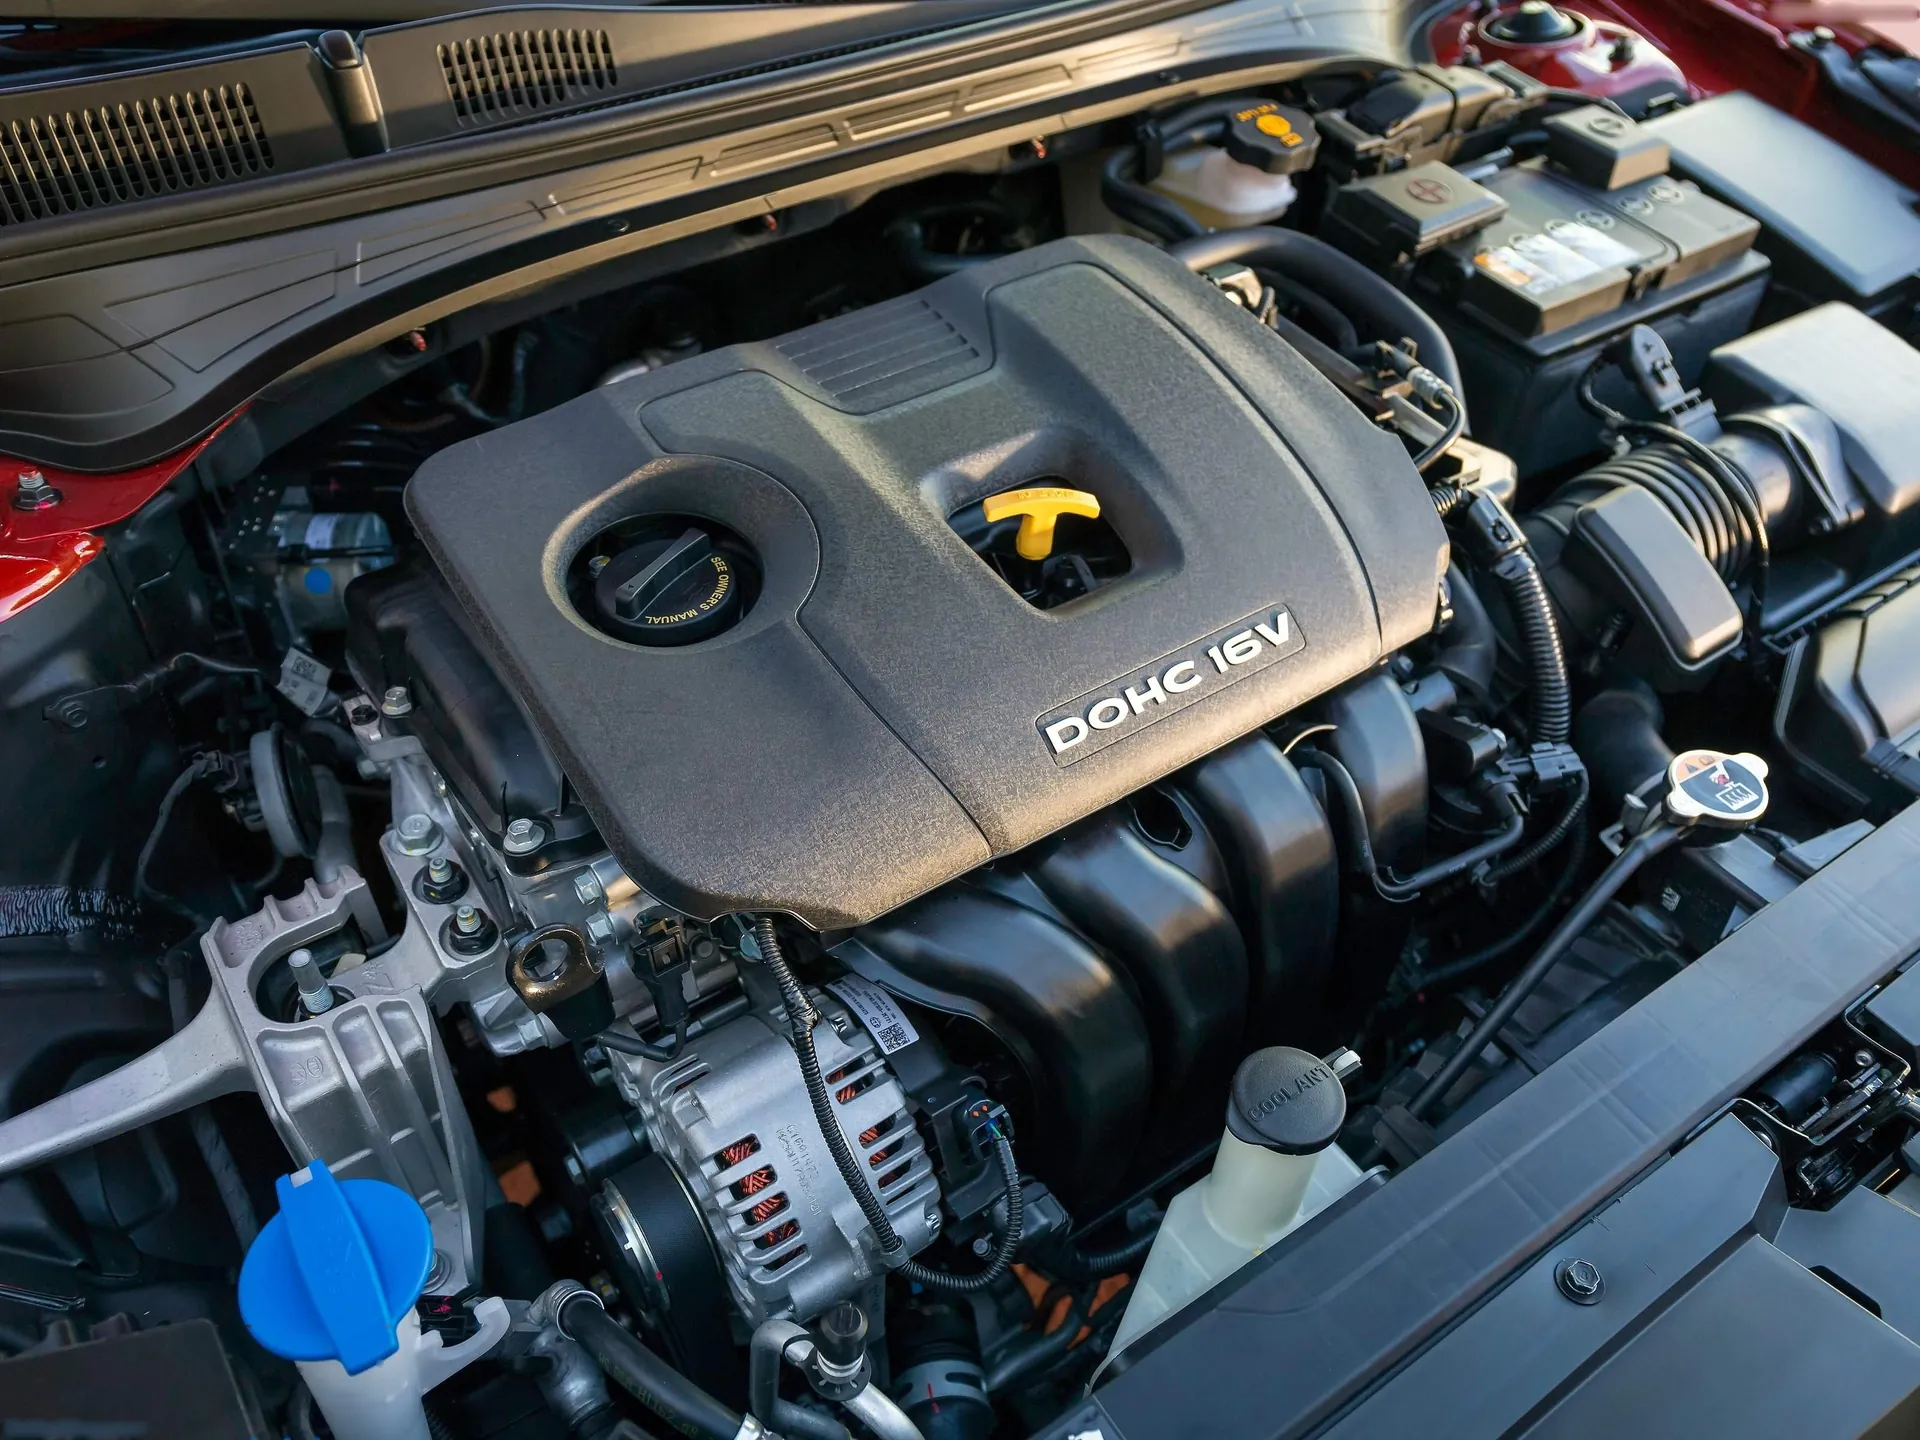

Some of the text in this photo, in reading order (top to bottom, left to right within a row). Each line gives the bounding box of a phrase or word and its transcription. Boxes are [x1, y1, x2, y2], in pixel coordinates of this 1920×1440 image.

[645, 556, 730, 624] SEE OWNER'S MANUAL
[1045, 611, 1290, 754] DOHC 16V
[1248, 1064, 1330, 1122] COOLANT
